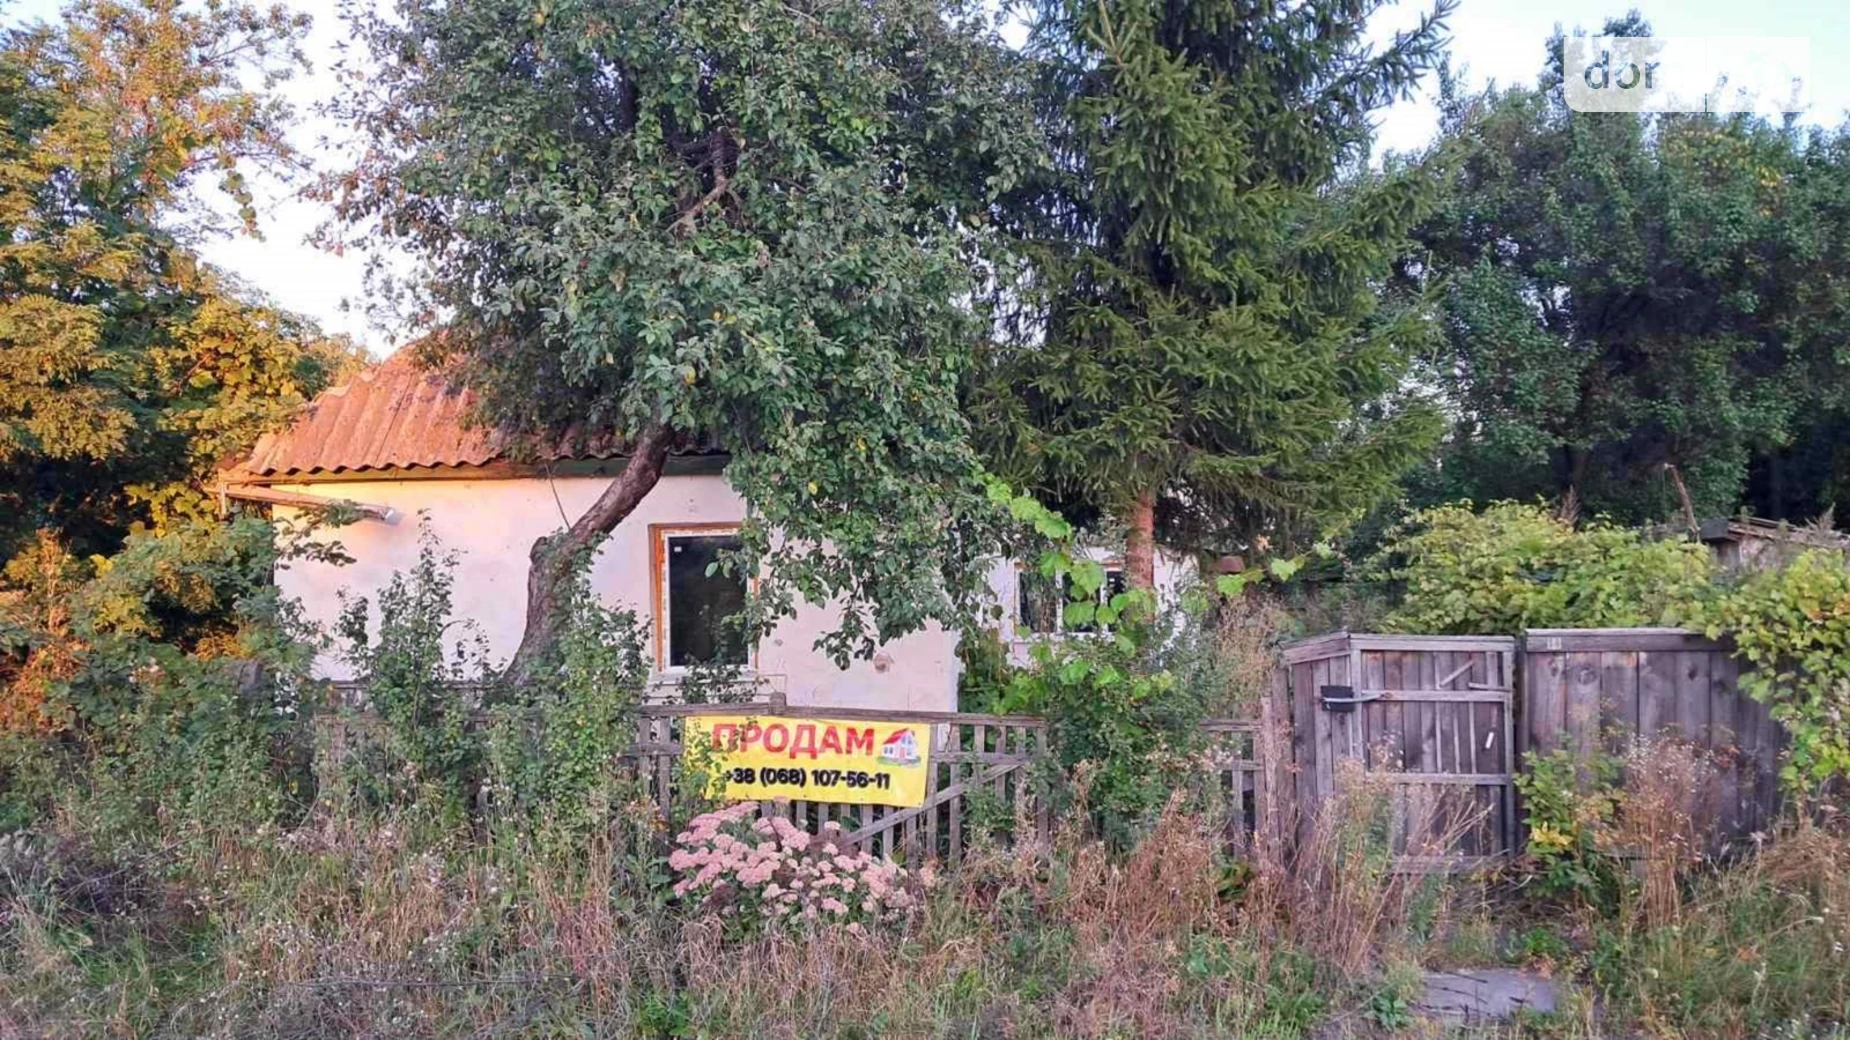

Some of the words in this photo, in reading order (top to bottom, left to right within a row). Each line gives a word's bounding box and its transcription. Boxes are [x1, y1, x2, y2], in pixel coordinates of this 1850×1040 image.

[711, 723, 875, 759] ПРОДАМ
[722, 767, 756, 784] +38
[760, 767, 806, 788] (068)
[811, 769, 890, 790] 107-56-11
